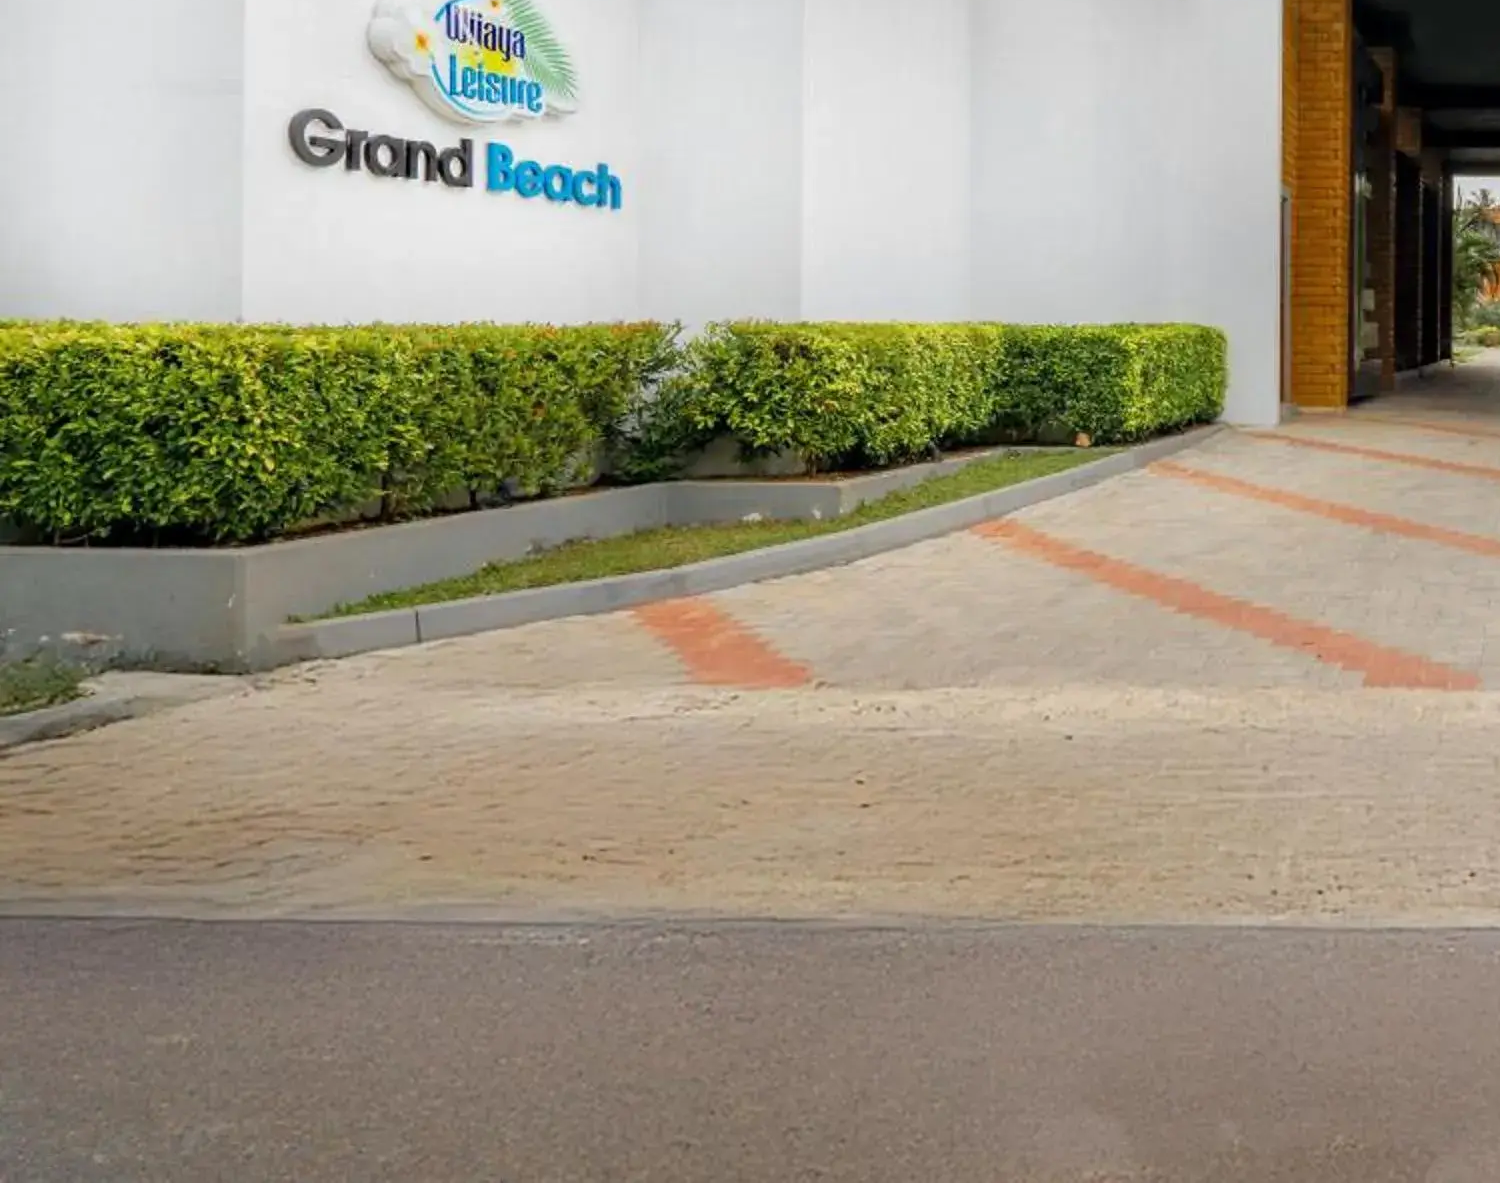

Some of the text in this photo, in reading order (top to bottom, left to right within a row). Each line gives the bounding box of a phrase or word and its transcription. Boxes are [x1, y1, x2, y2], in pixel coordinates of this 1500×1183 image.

[445, 2, 526, 62] Wijaya
[449, 53, 544, 113] Leisure
[288, 108, 622, 210] Grand Beach
